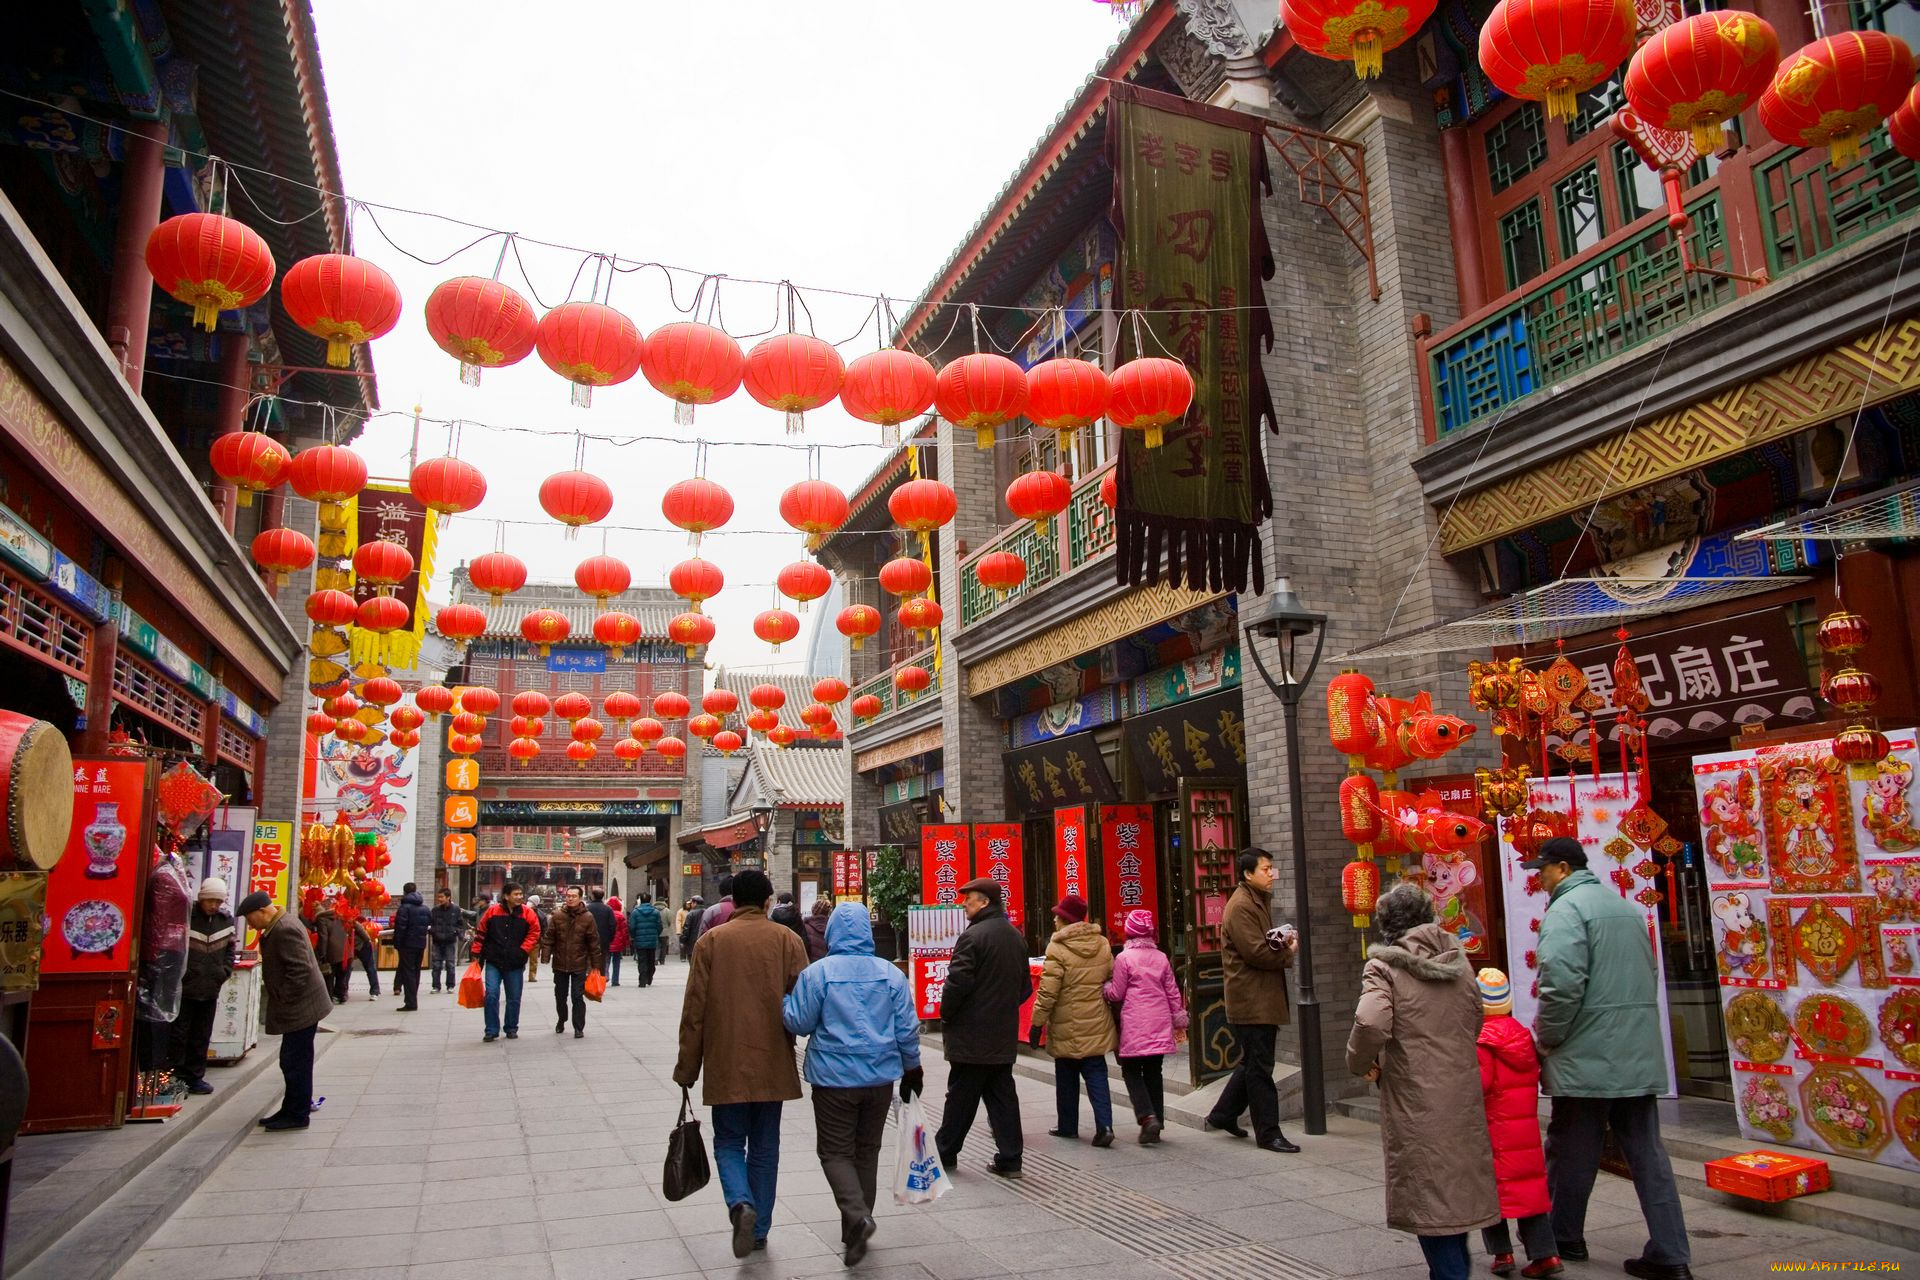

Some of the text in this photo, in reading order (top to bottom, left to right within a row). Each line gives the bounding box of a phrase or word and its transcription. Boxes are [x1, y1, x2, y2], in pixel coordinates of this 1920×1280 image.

[1138, 132, 1233, 183] 老字号
[1558, 674, 1572, 689] 福
[1571, 635, 1780, 718] 星记扇庄
[1147, 709, 1247, 779] 紫金堂
[73, 784, 111, 794] NNE WARE
[1018, 750, 1094, 802] 紫金堂
[934, 839, 958, 905] 紫金堂
[1115, 822, 1144, 907] 紫金堂
[0, 920, 28, 943] 乐器
[3, 964, 26, 974] 公司
